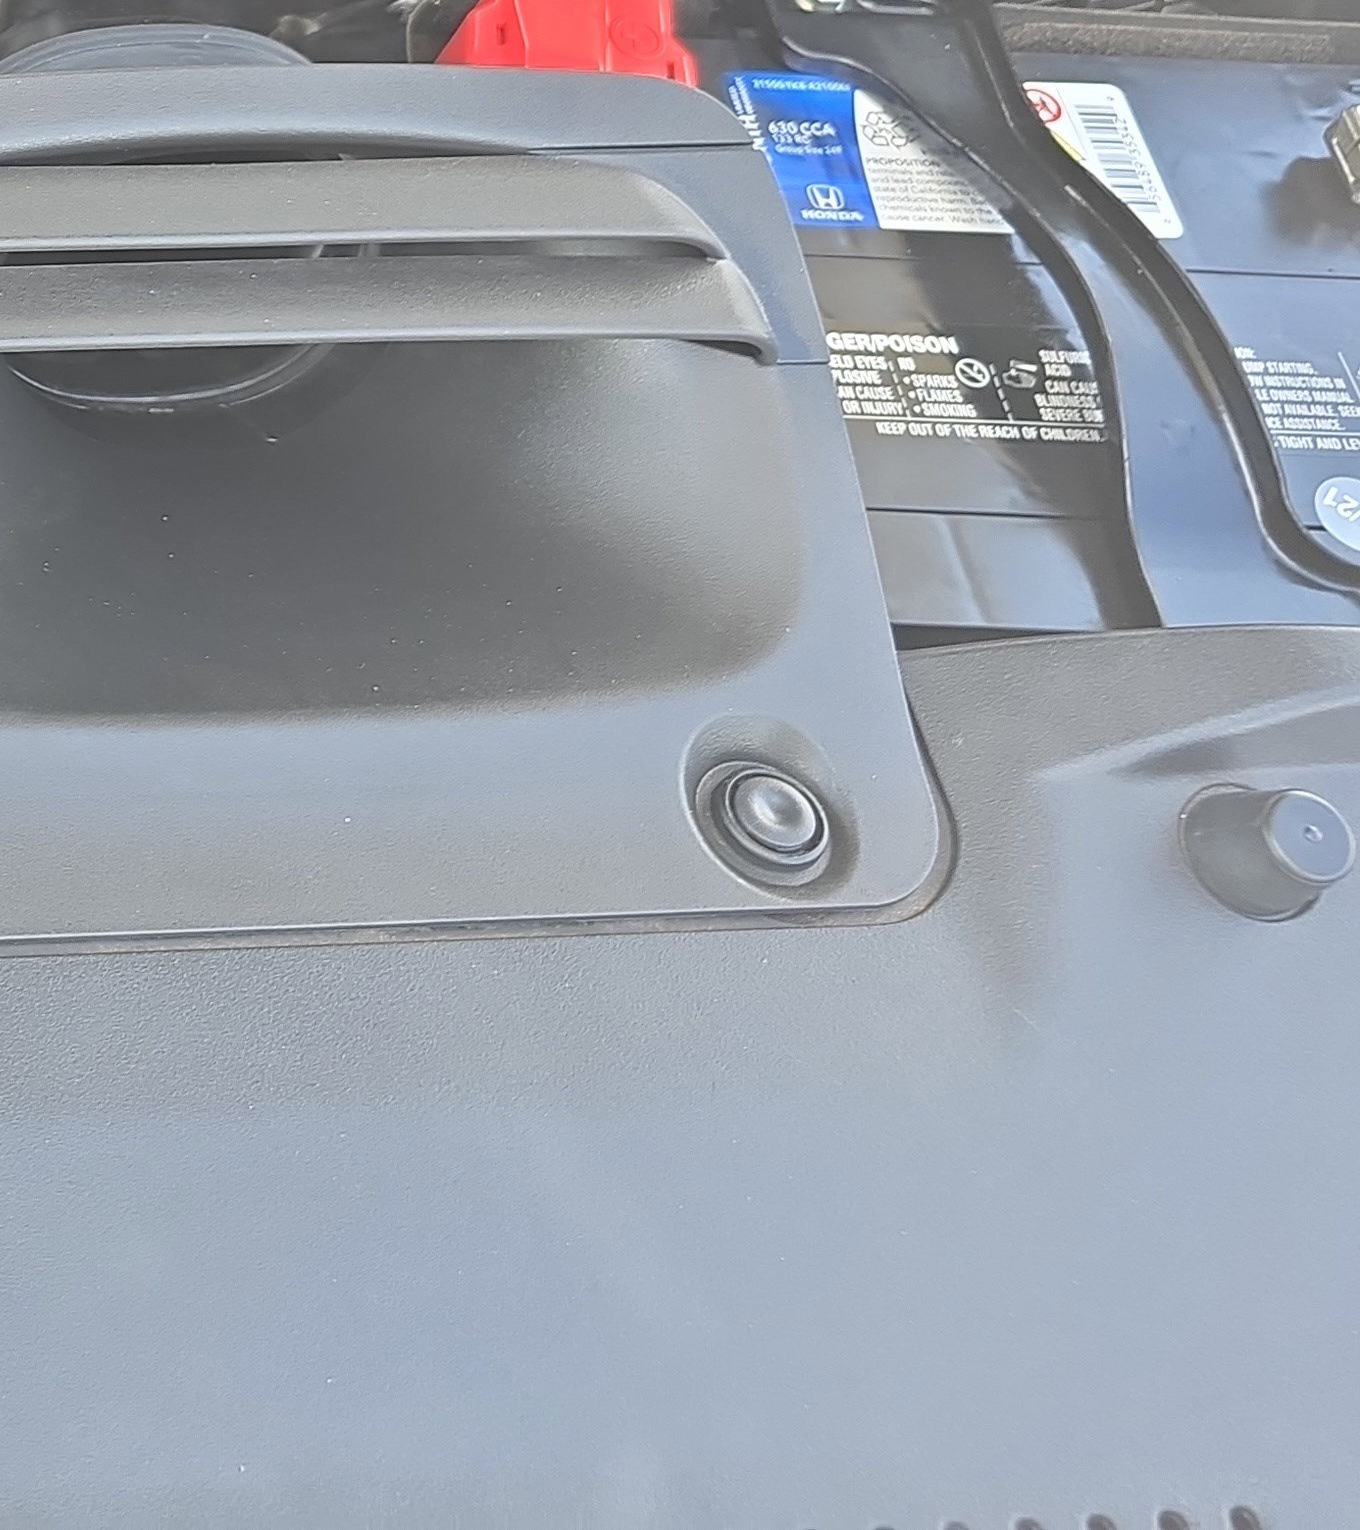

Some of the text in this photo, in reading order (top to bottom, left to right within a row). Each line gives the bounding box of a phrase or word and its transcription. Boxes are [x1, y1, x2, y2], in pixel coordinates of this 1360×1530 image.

[768, 120, 836, 137] 630 CCA
[800, 209, 864, 221] HONDA
[826, 332, 959, 354] GER/POISON
[830, 354, 888, 370] ELD EYES
[897, 357, 916, 371] NO
[1241, 361, 1265, 374] UMP
[831, 369, 883, 385] PLOSIVE
[911, 374, 959, 389] SPARKS
[1263, 374, 1334, 389] INSTRUCTIONS
[1333, 377, 1347, 389] IN
[837, 385, 896, 400] AN CAUSE
[1044, 379, 1070, 394] CAN
[916, 388, 964, 403] FLAMES
[1269, 388, 1313, 402] OWNERS
[842, 400, 904, 415] OR INJURY
[921, 402, 978, 418] SMOKING
[1039, 407, 1083, 421] SEVERE
[875, 421, 907, 435] KEEP
[908, 422, 934, 436] OUT
[935, 423, 952, 437] OF
[952, 424, 978, 438] THE
[978, 424, 1020, 439] REACH
[1021, 426, 1038, 440] OF
[1277, 435, 1314, 449] TIGHT
[1316, 436, 1342, 450] AND
